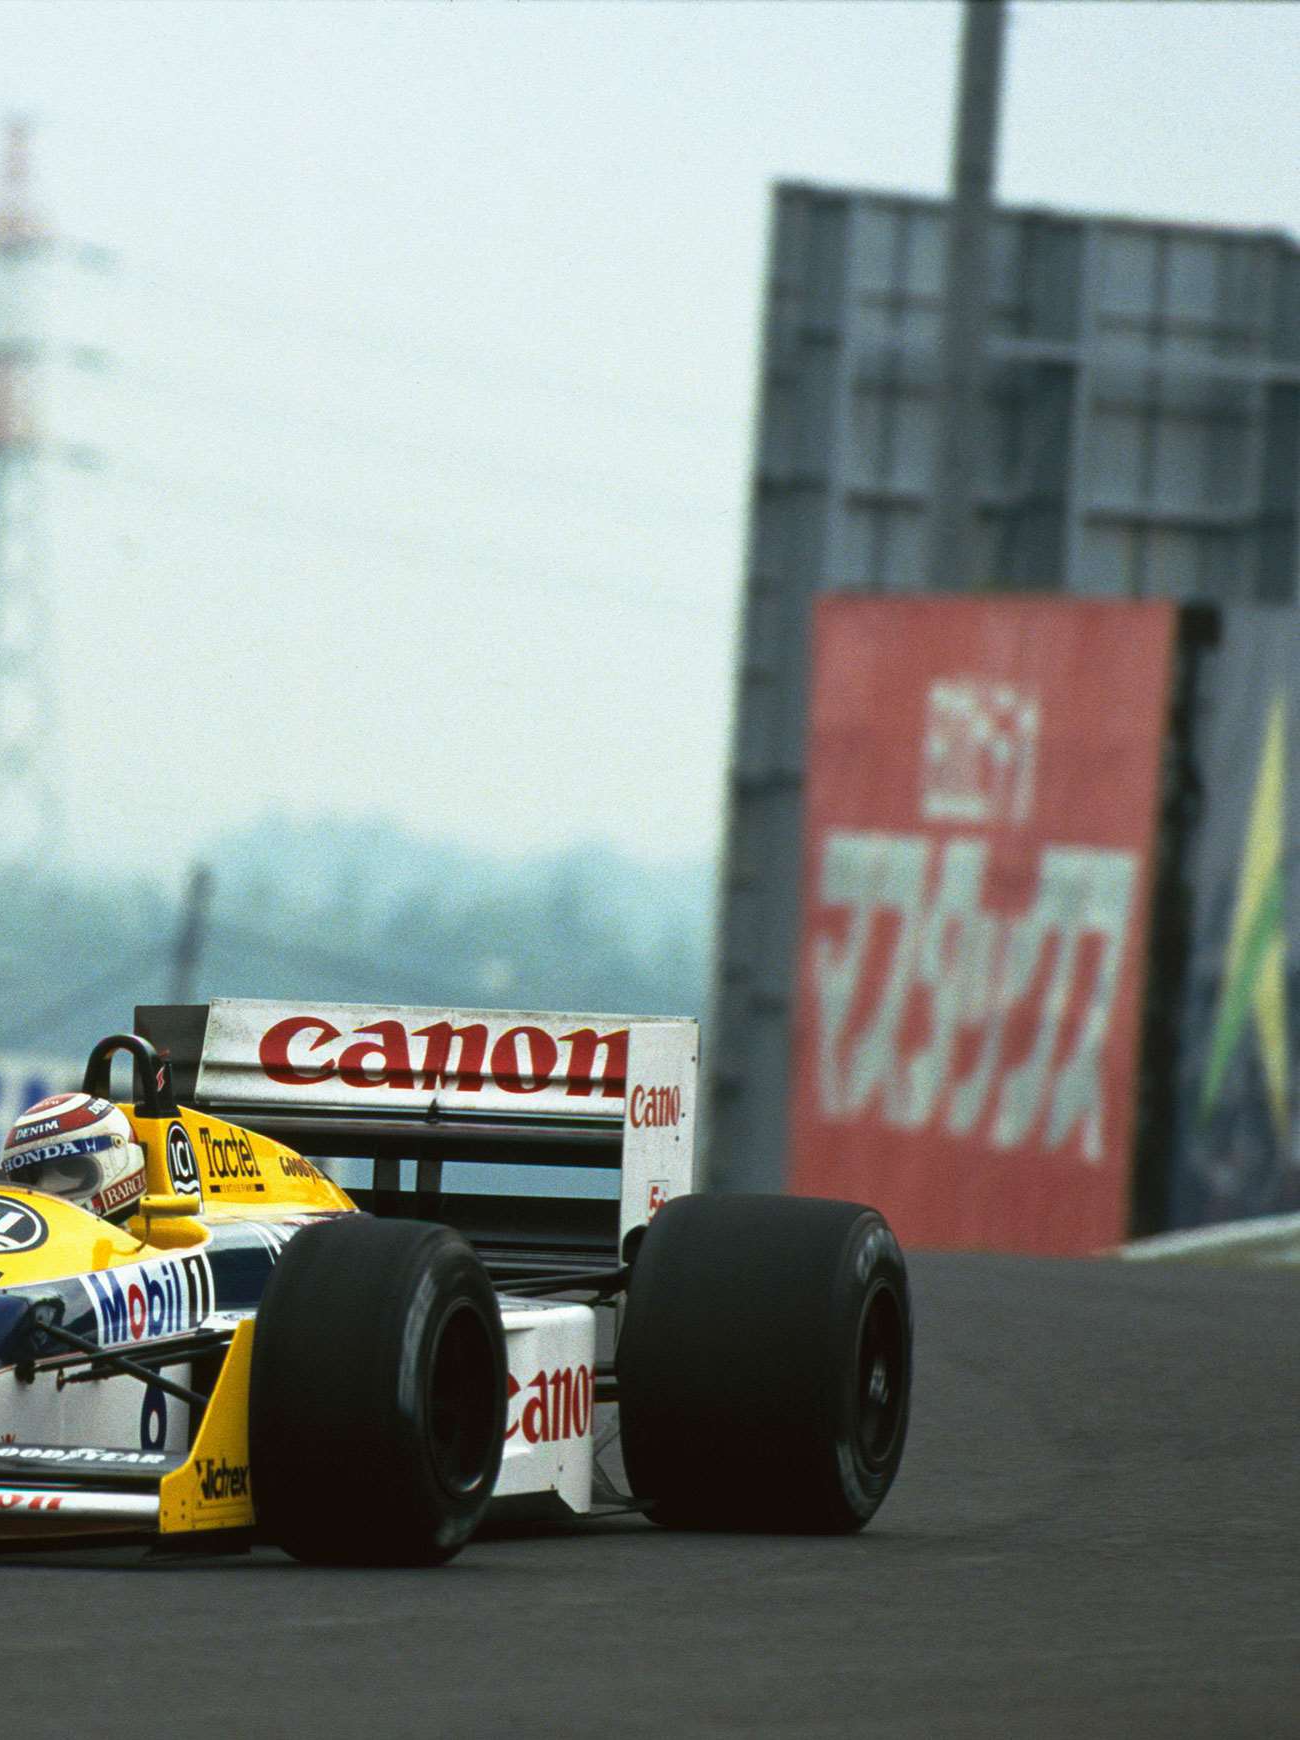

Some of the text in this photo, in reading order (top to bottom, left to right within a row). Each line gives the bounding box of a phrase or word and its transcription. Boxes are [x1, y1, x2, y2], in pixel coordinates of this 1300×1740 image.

[259, 1016, 629, 1098] Canon
[13, 1119, 59, 1142] DENIM
[199, 1127, 261, 1178] Tactel
[2, 1141, 80, 1173] HONDA
[170, 1140, 193, 1177] ICI
[87, 1260, 182, 1344] Mobil
